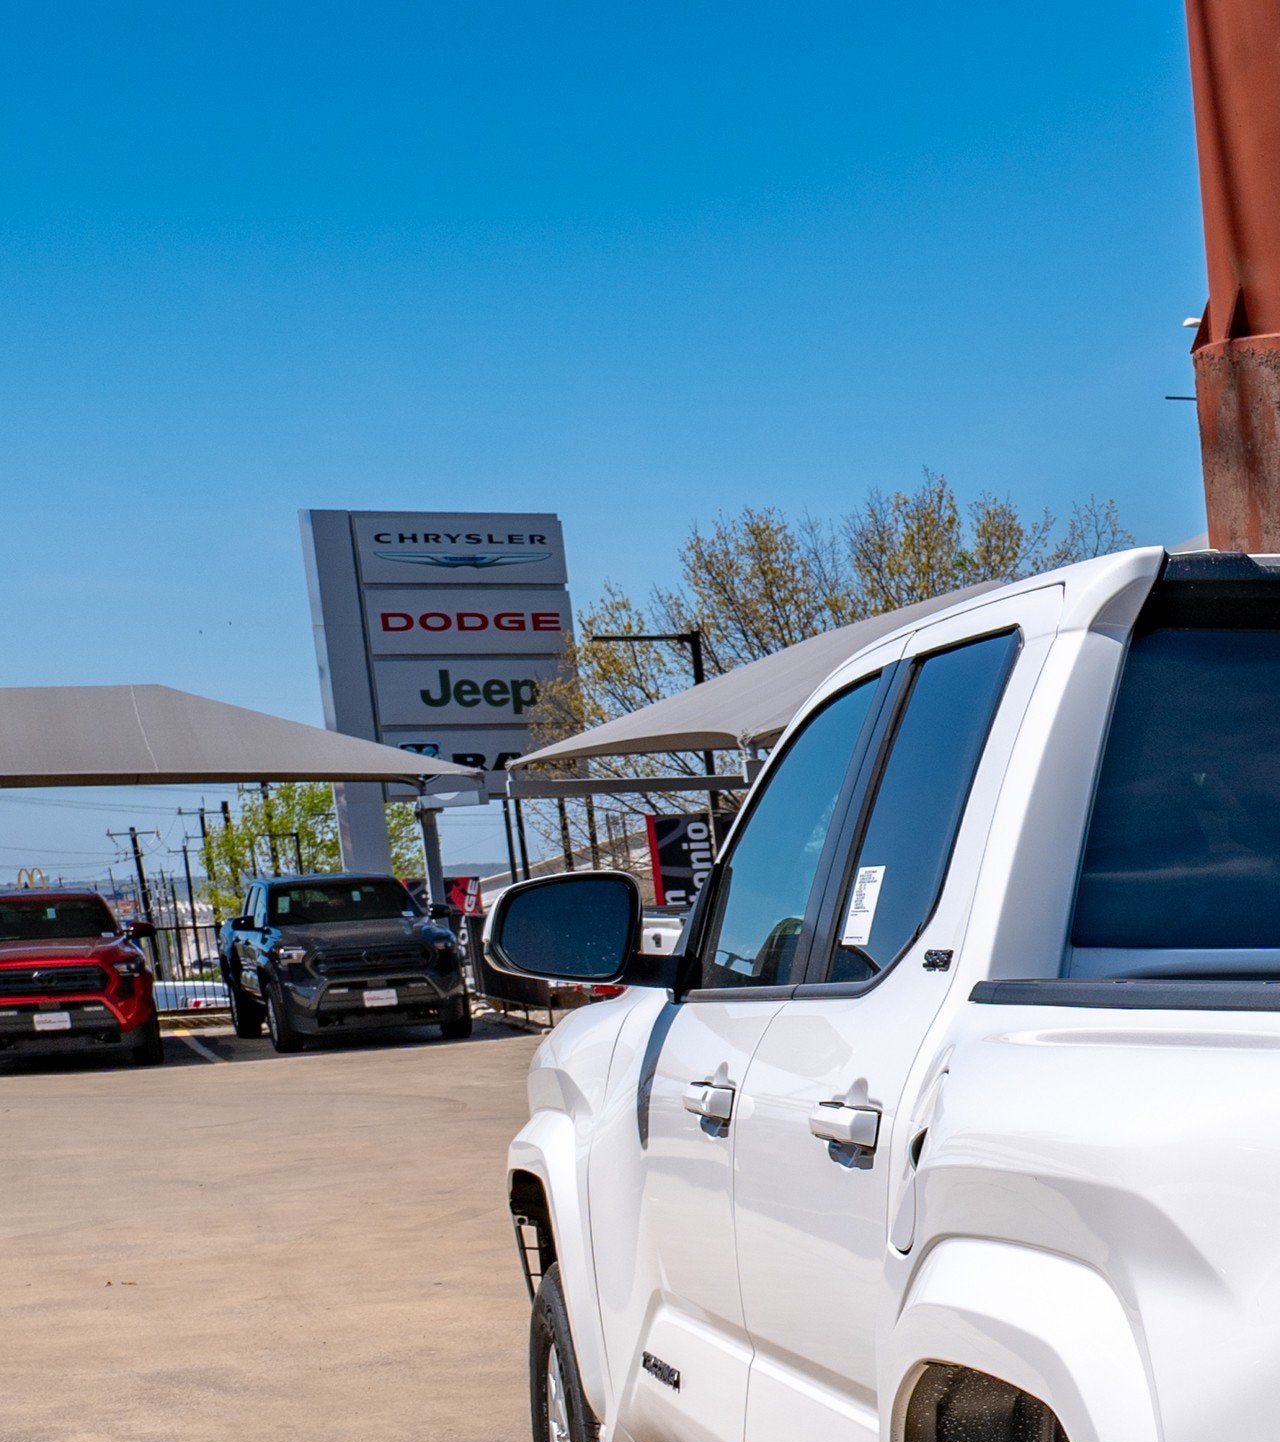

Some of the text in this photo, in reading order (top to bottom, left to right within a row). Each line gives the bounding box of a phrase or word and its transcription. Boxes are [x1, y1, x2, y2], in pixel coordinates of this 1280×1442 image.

[374, 532, 547, 546] CHRYSLER
[380, 612, 562, 632] DODGE
[420, 669, 540, 714] Jeep
[682, 821, 713, 902] onio
